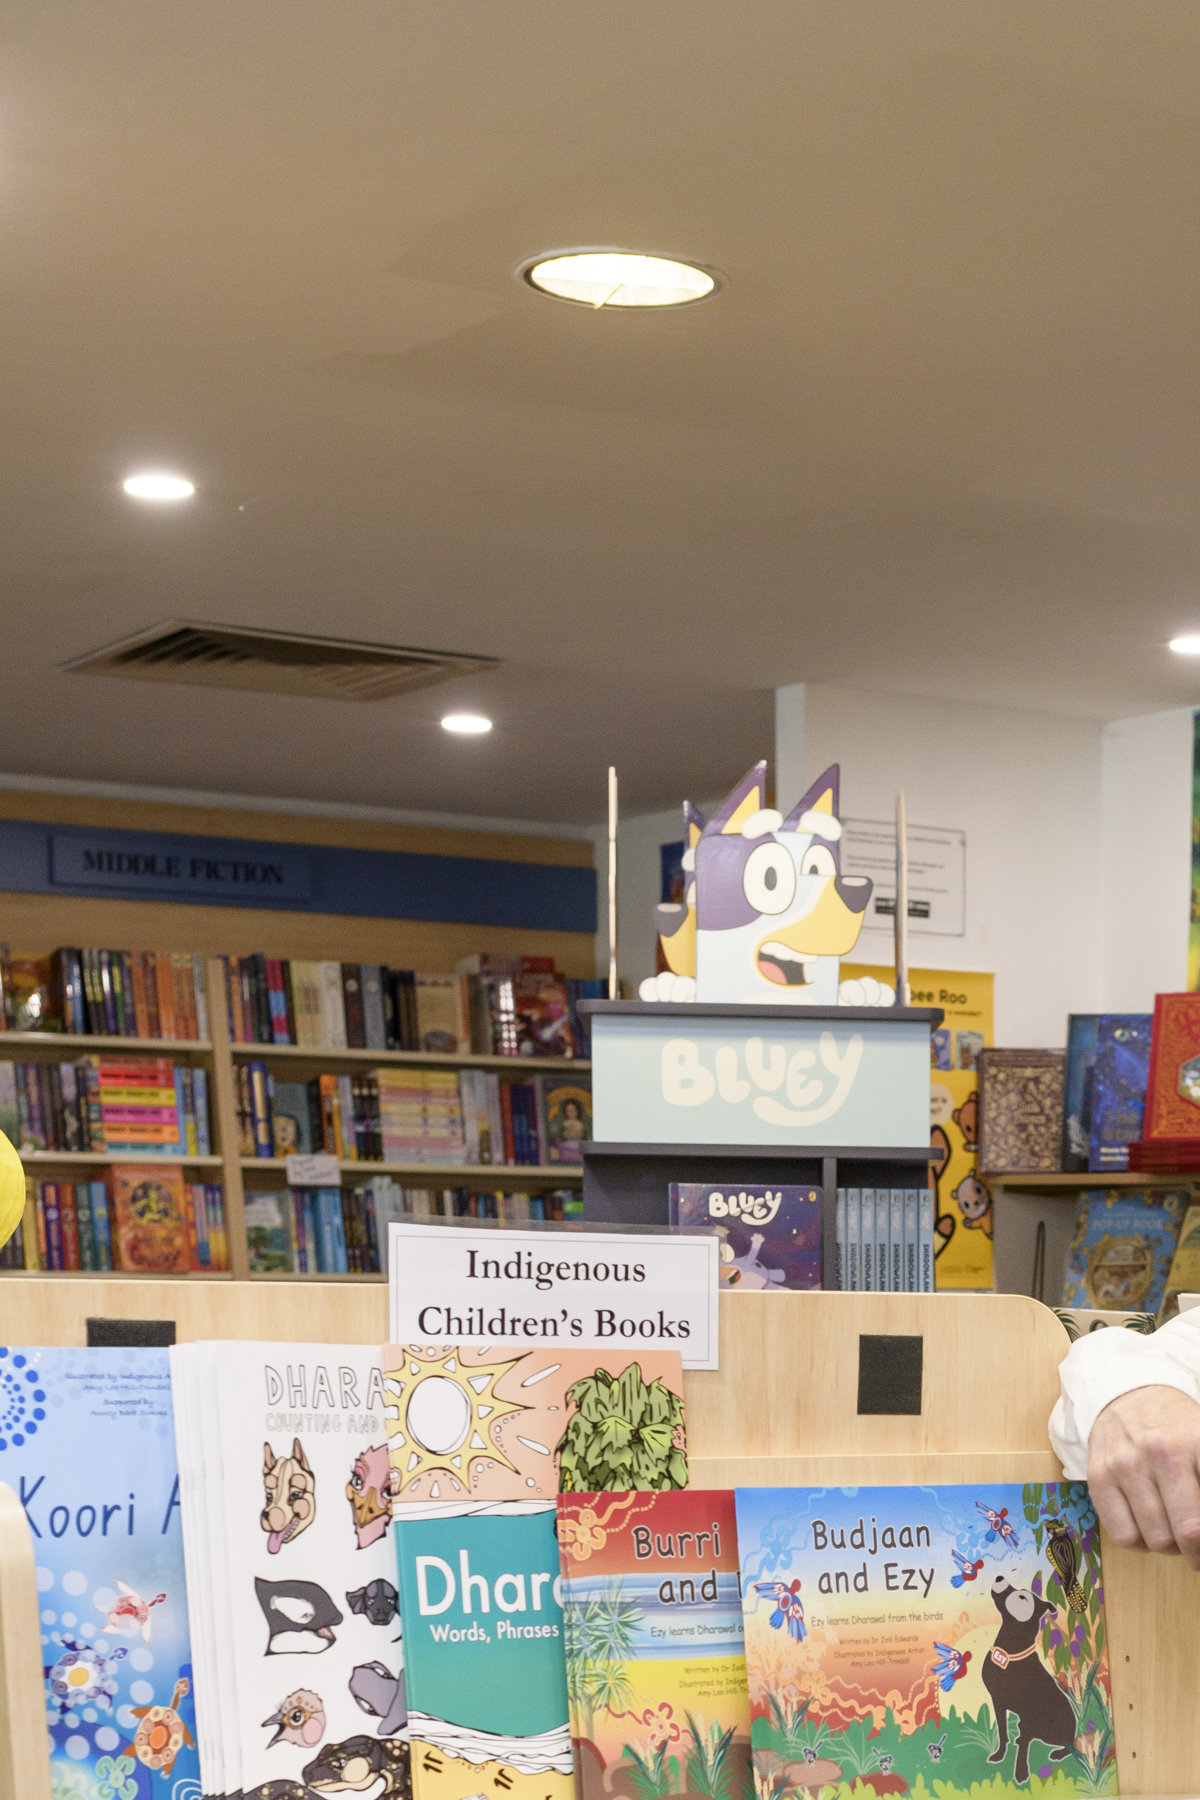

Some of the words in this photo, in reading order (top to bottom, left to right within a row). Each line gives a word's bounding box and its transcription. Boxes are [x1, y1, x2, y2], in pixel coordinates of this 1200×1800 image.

[84, 850, 180, 878] MIDDLE
[190, 857, 283, 884] FICTION
[940, 989, 967, 1005] Roo
[660, 1031, 864, 1127] BLUEY
[708, 1190, 783, 1226] BLUEY
[466, 1250, 646, 1290] Indigenous
[418, 1306, 583, 1337] Children's
[594, 1309, 691, 1338] Books
[265, 1413, 342, 1433] COUNTING
[347, 1414, 379, 1433] AND
[20, 1475, 135, 1537] Koori
[632, 1522, 721, 1559] Burri
[811, 1517, 931, 1555] Budjaan
[658, 1569, 718, 1604] and
[818, 1562, 869, 1594] and
[884, 1562, 935, 1599] Ezy
[429, 1621, 492, 1645] Words,
[497, 1619, 560, 1640] Phrases
[650, 1625, 667, 1639] Ezy
[668, 1625, 695, 1638] learns
[697, 1623, 737, 1636] Dharawal
[811, 1617, 825, 1628] Ezy
[827, 1615, 850, 1626] learns
[851, 1614, 886, 1625] Dharawal
[888, 1613, 907, 1624] from
[909, 1612, 922, 1622] the
[923, 1611, 944, 1622] birds
